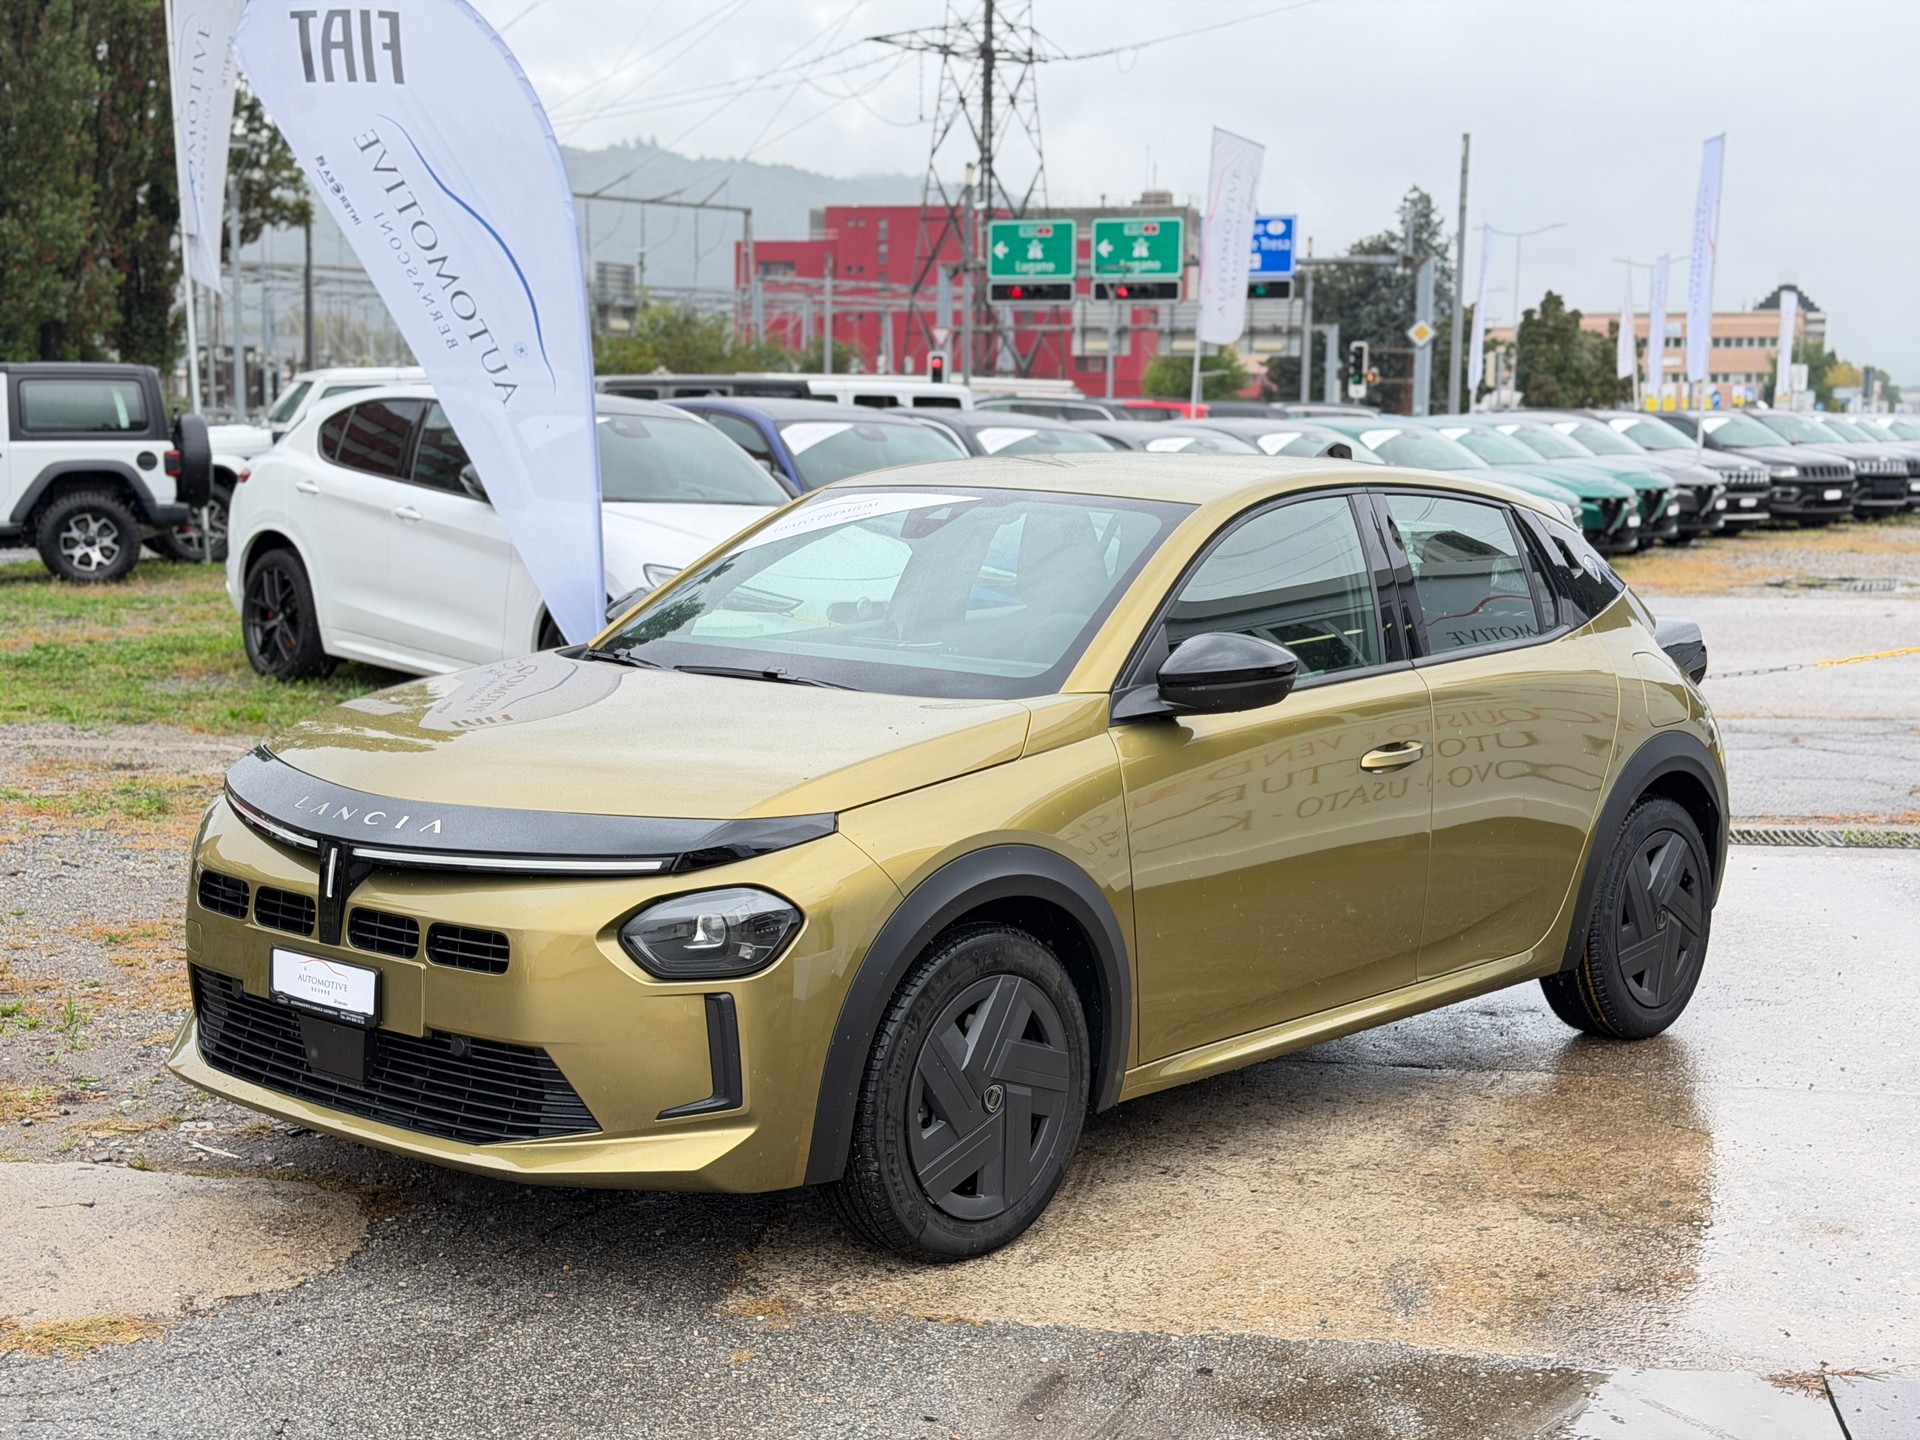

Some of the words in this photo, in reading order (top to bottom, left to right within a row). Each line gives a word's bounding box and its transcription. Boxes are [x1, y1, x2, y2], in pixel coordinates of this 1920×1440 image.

[187, 23, 211, 163] MOTIVE
[1015, 260, 1056, 276] Lugano
[1119, 258, 1162, 275] Lugano
[294, 795, 442, 835] LANCIA
[297, 973, 349, 993] AUTOMOTIVE
